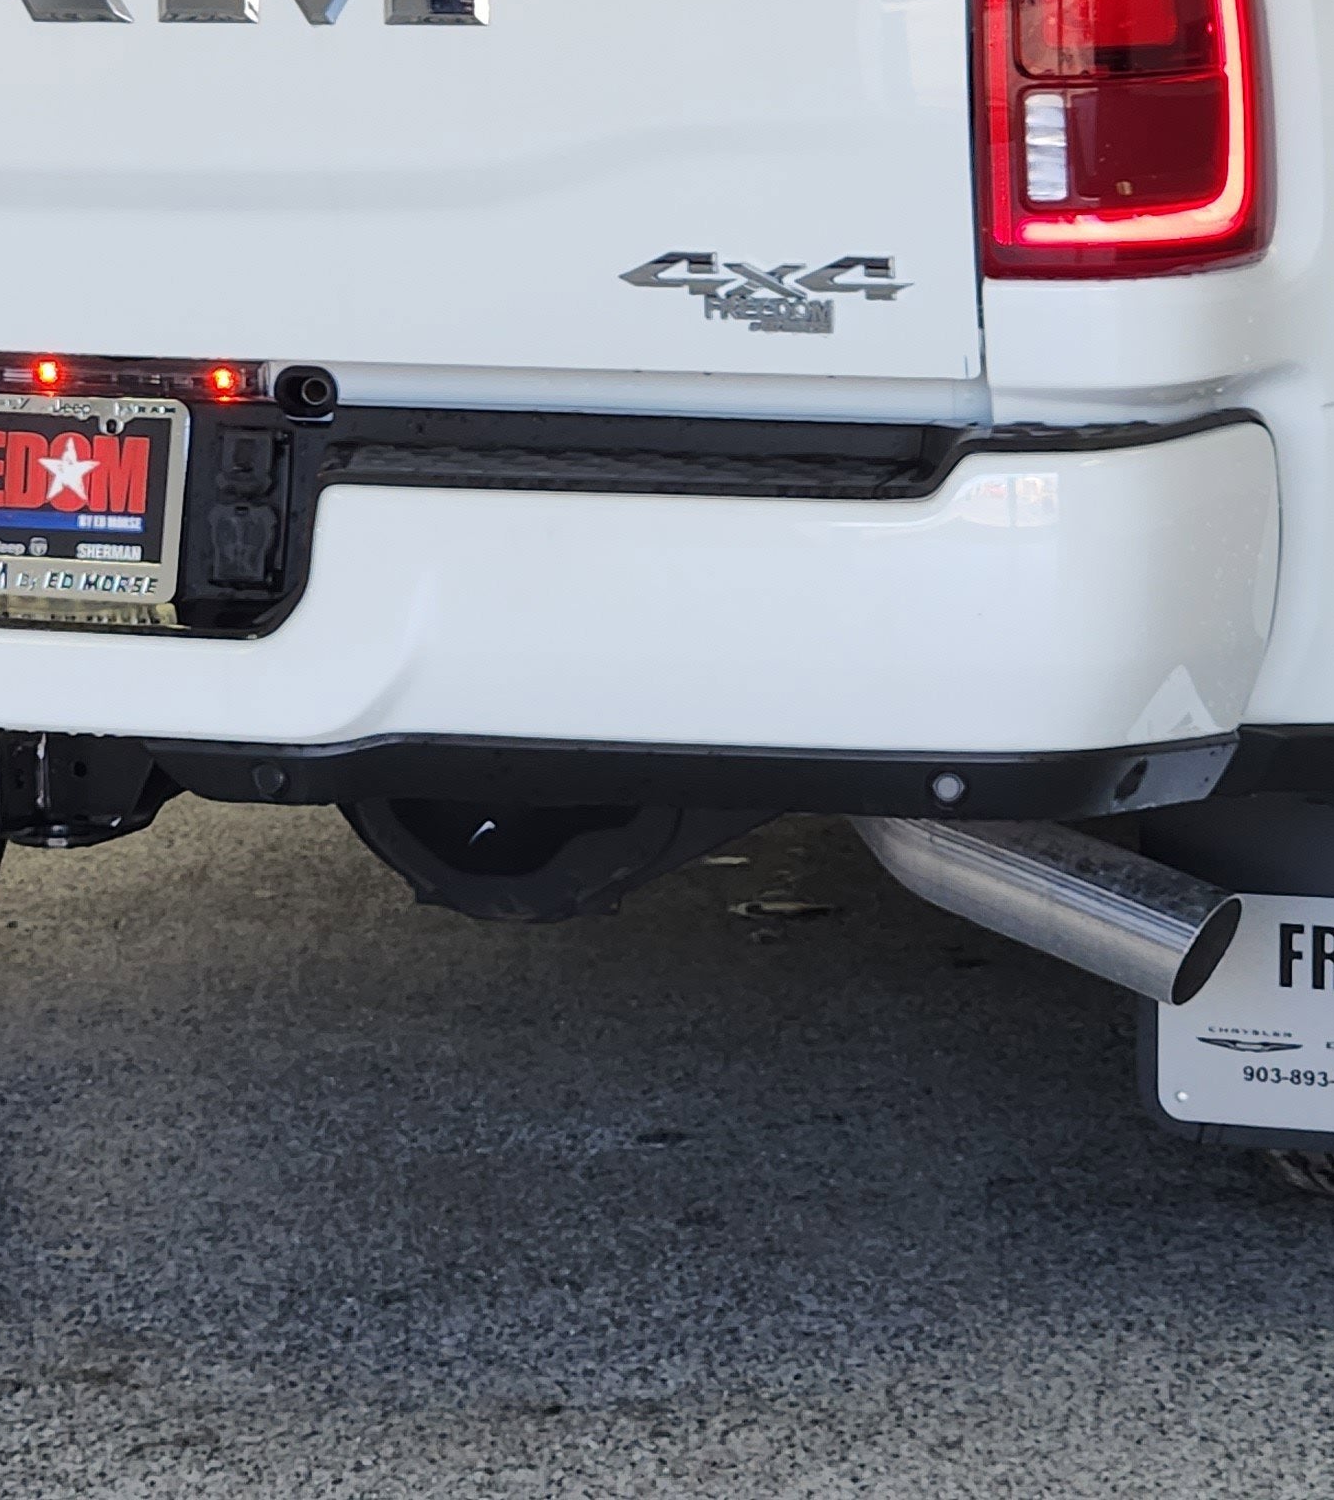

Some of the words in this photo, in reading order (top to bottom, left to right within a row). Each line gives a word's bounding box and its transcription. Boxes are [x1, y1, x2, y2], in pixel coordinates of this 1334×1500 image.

[77, 543, 142, 561] SHERMAN
[43, 571, 74, 590] ED
[78, 572, 159, 596] MORSE
